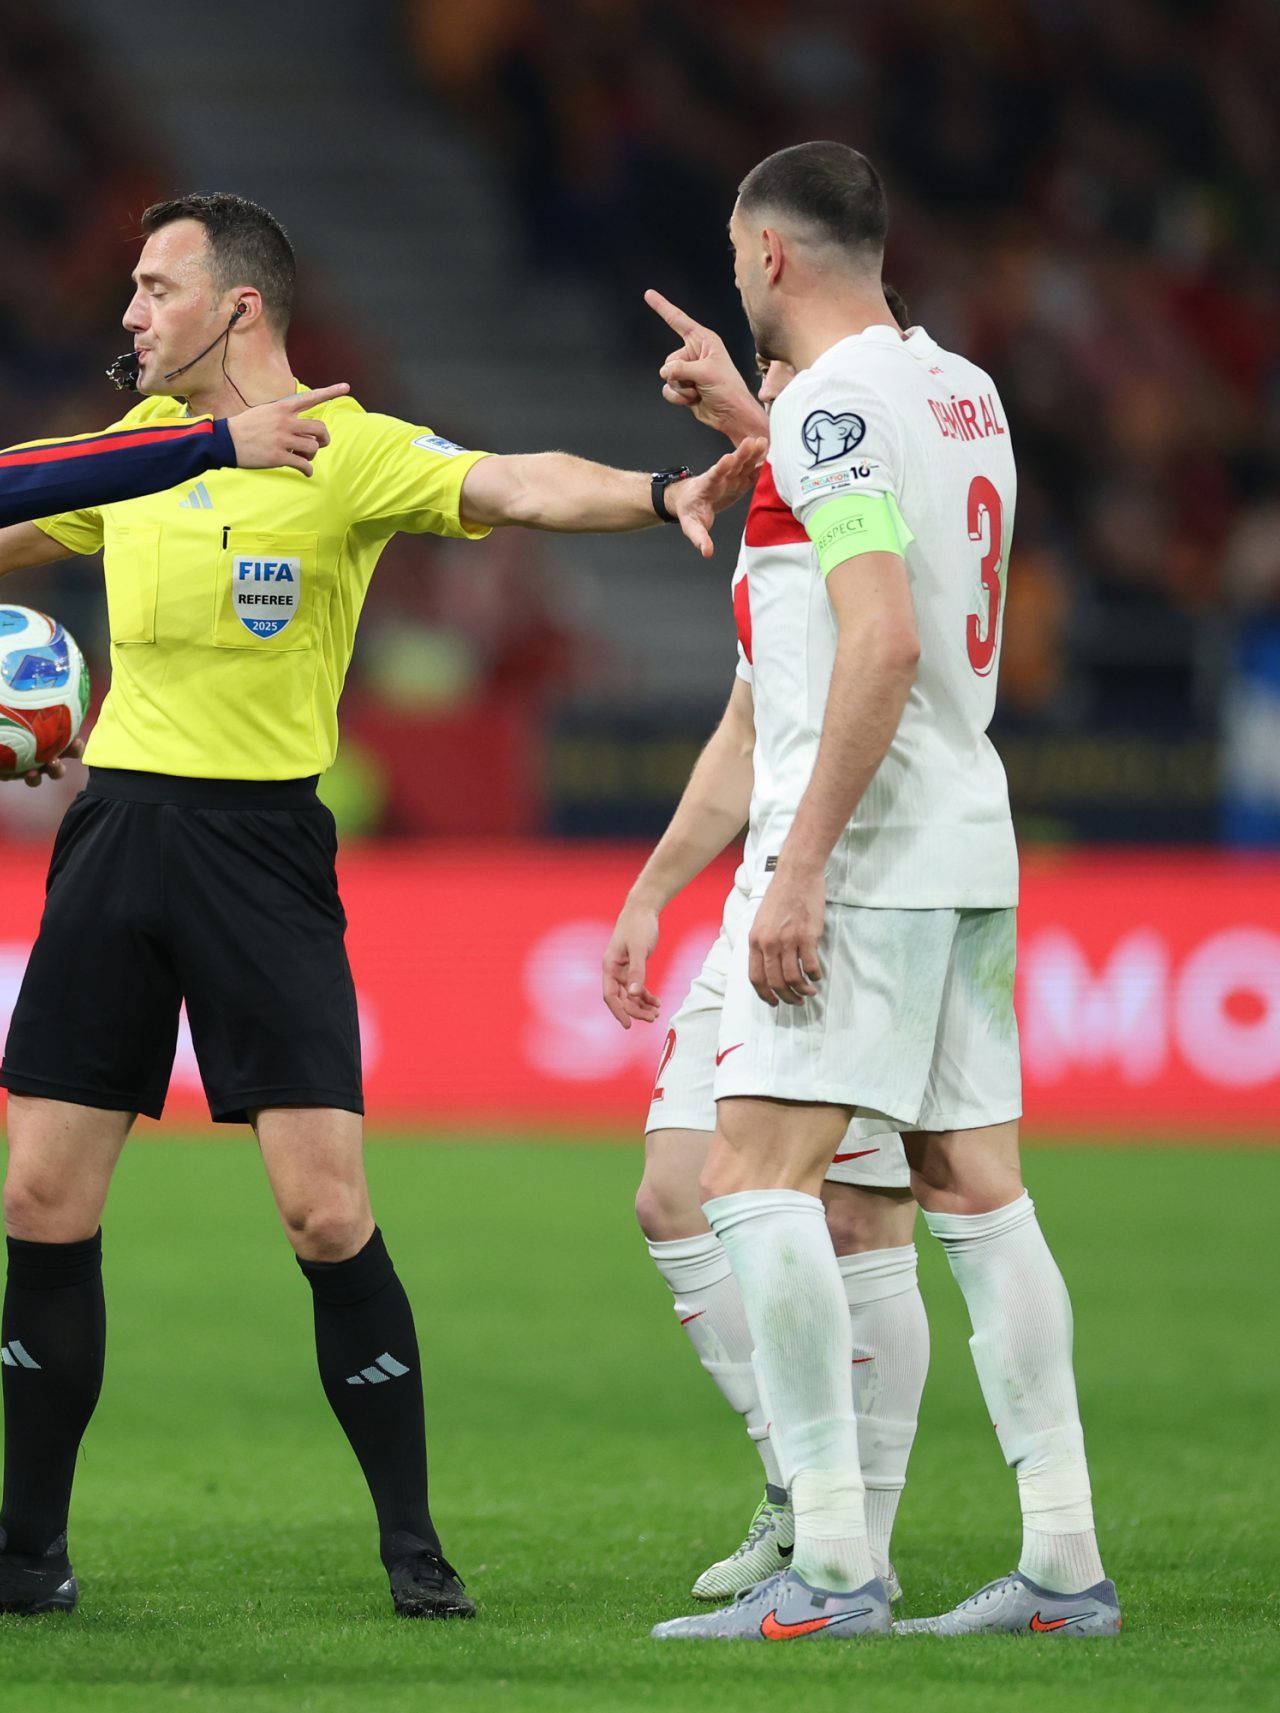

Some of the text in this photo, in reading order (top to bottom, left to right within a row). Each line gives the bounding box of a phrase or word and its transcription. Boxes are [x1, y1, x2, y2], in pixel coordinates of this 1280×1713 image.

[818, 517, 865, 551] RESPECT
[239, 562, 294, 582] FIFA
[966, 475, 1004, 677] 3
[238, 593, 294, 606] REFEREE
[252, 621, 278, 631] 2025
